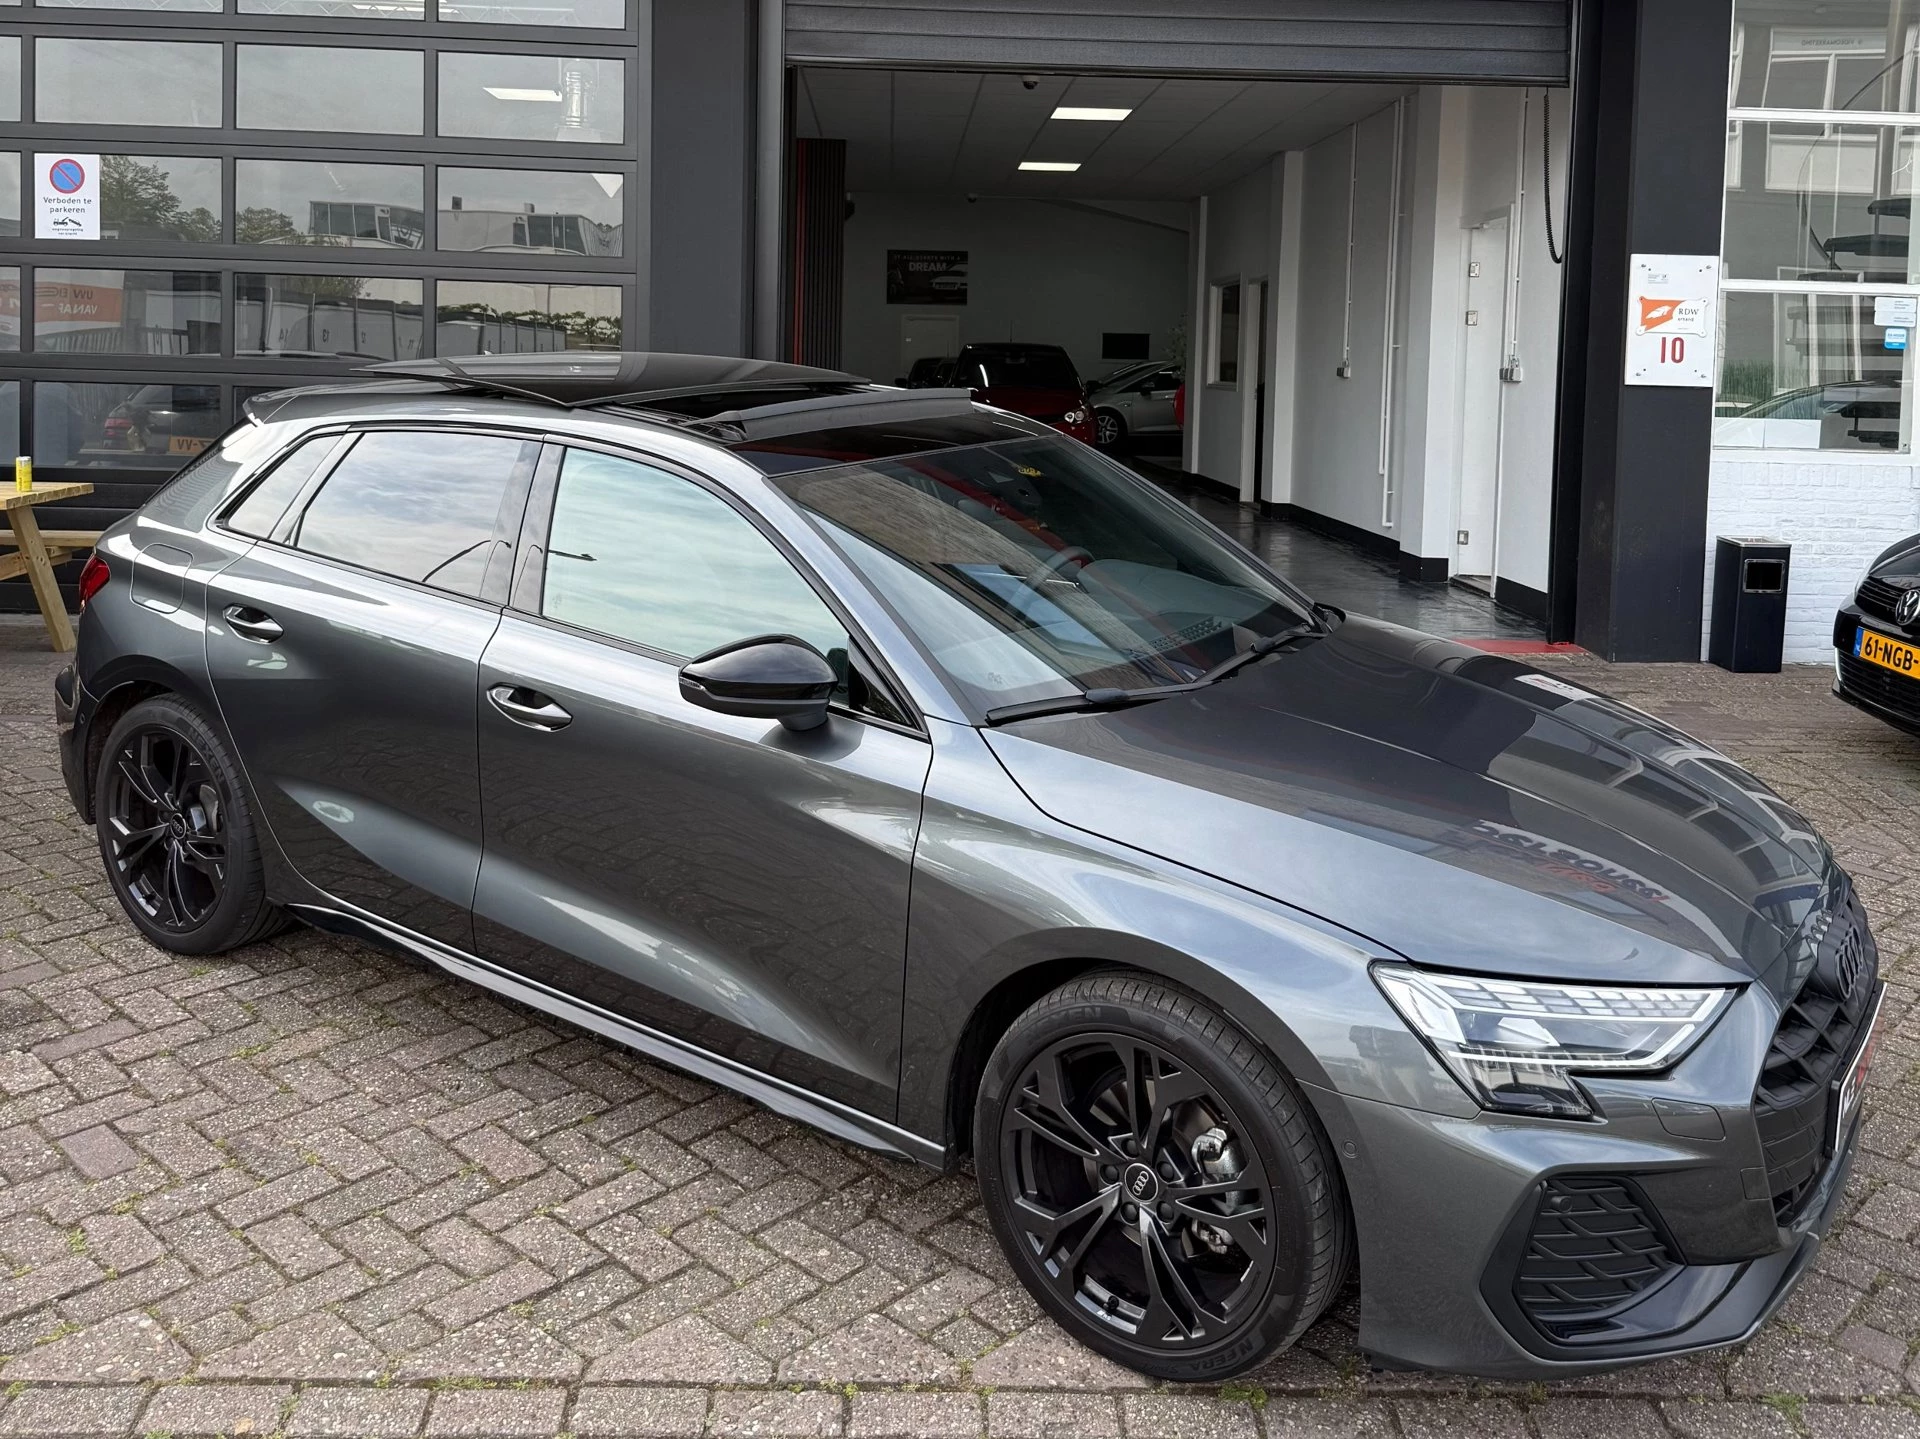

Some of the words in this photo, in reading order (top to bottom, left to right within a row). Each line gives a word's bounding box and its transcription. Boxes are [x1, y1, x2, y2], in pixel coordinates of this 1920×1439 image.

[43, 196, 81, 204] Verboden
[49, 206, 86, 214] parkeren
[909, 262, 947, 272] DREAM
[1678, 308, 1700, 316] RDW
[1660, 336, 1685, 364] 10
